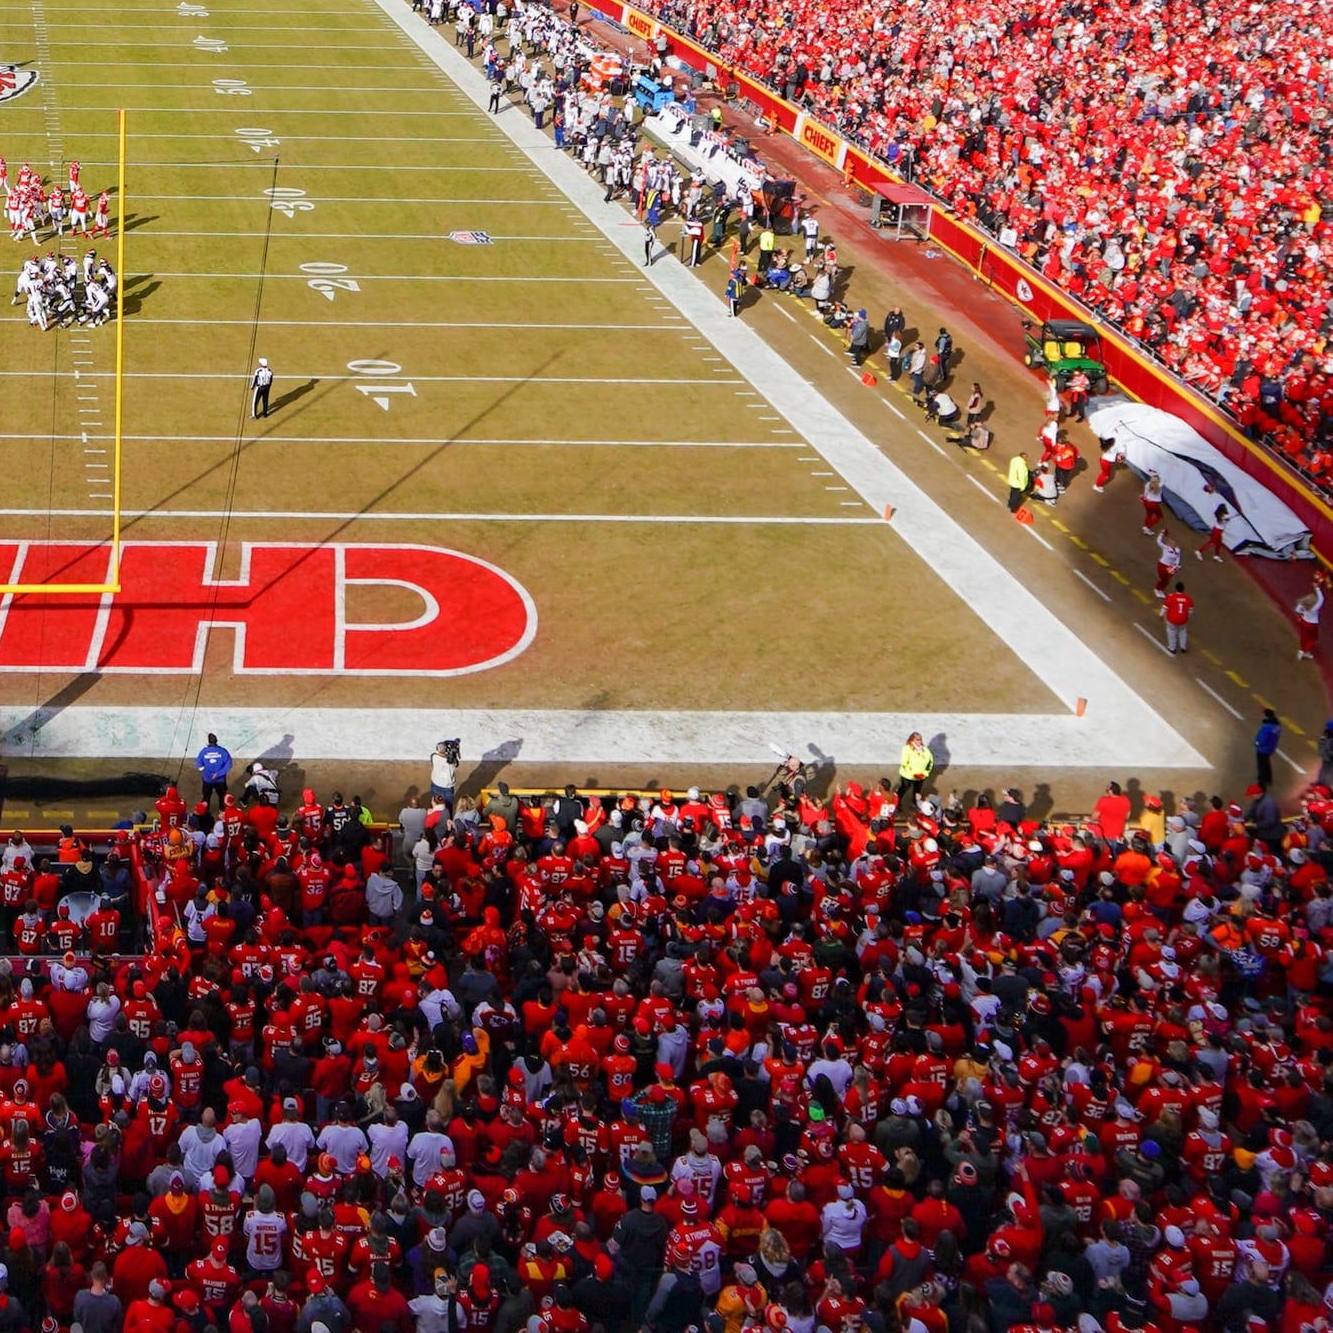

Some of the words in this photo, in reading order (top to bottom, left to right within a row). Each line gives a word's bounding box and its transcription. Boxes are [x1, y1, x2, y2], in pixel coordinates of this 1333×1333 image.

[628, 13, 652, 37] CHIEFS
[211, 79, 253, 95] 50
[234, 128, 280, 147] 40
[804, 125, 836, 158] CHIEFS
[262, 187, 315, 211] 30
[299, 262, 361, 292] 20
[346, 358, 417, 397] 10
[717, 815, 733, 828] 15
[551, 872, 569, 885] 87
[4, 884, 21, 901] 87
[307, 884, 324, 895] 32
[100, 921, 115, 936] 10
[21, 930, 38, 944] 87
[59, 935, 72, 949] 15
[1259, 935, 1280, 948] 58
[618, 945, 636, 963] 15
[358, 980, 377, 995] 87
[812, 983, 830, 999] 87
[18, 1019, 37, 1034] 87
[304, 1010, 322, 1027] 95
[129, 1020, 150, 1039] 95
[568, 1063, 590, 1079] 56
[612, 1072, 632, 1086] 80
[149, 1117, 166, 1136] 17
[204, 1214, 234, 1237] 58
[254, 1233, 278, 1255] 15
[690, 1250, 716, 1271] 58
[202, 1279, 227, 1288] MAHOMES
[203, 1287, 225, 1300] 15
